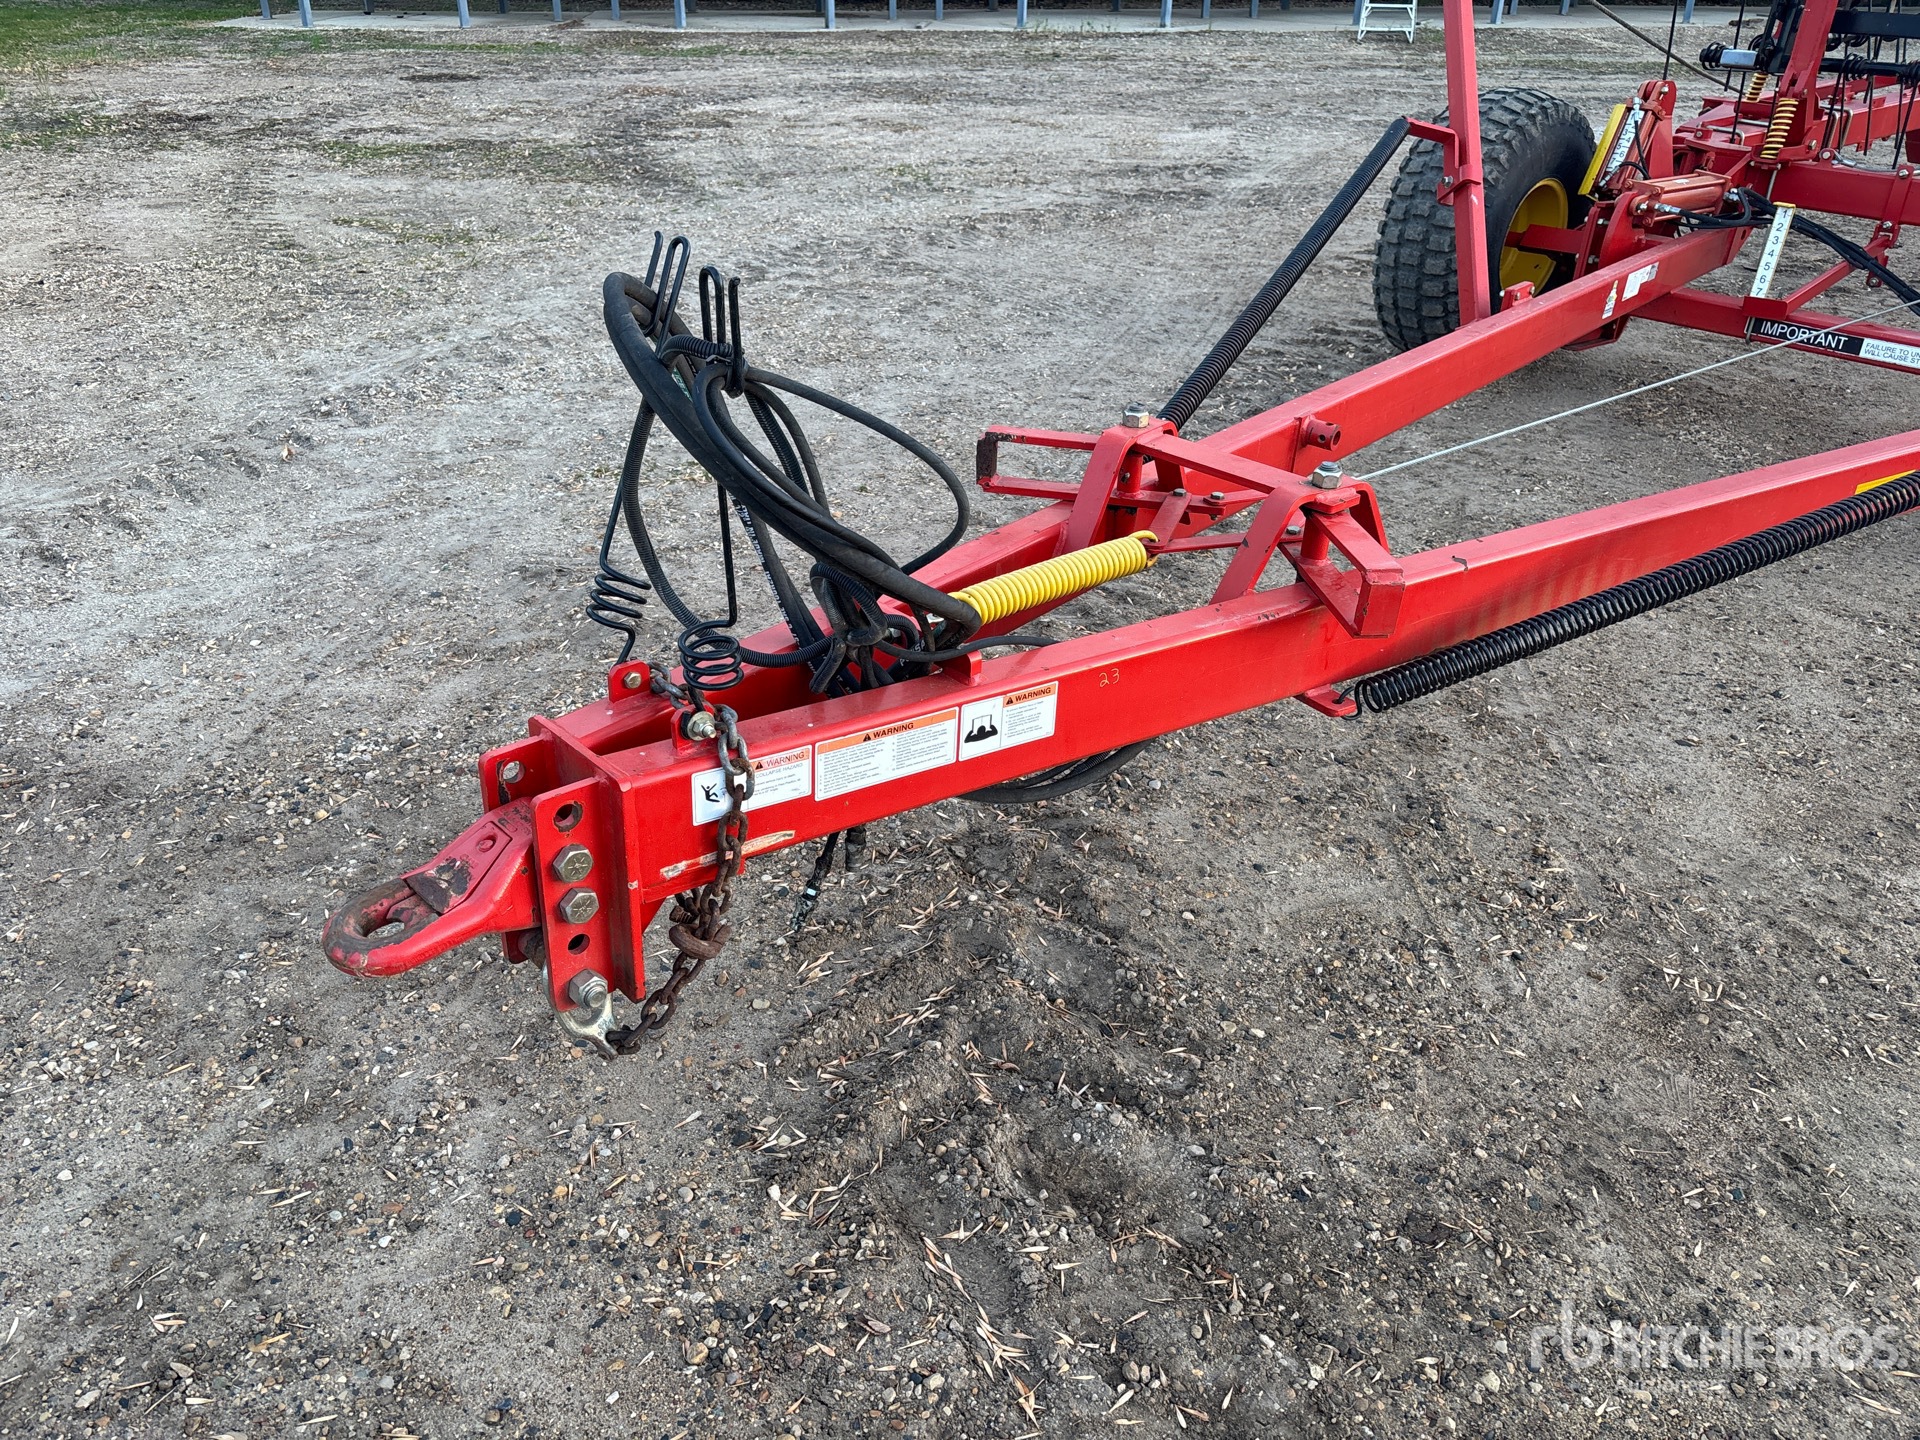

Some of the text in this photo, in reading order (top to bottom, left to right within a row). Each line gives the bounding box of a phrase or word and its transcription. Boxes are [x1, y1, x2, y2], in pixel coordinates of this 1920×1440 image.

[1782, 210, 1788, 219] 1
[1776, 222, 1784, 232] 2
[1771, 236, 1780, 245] 3
[1767, 249, 1775, 258] 4
[1763, 263, 1770, 271] 5
[1759, 275, 1767, 284] 6
[1755, 288, 1762, 296] 7
[1760, 320, 1849, 350] IMPORTANT
[1866, 342, 1898, 353] FAILURE
[1899, 348, 1909, 356] TO
[1865, 349, 1882, 357] WILL
[1882, 353, 1908, 362] CAUSE
[1098, 667, 1120, 688] 23
[1015, 687, 1051, 702] WARNING
[873, 722, 914, 739] WARNING
[766, 751, 805, 767] WARNING
